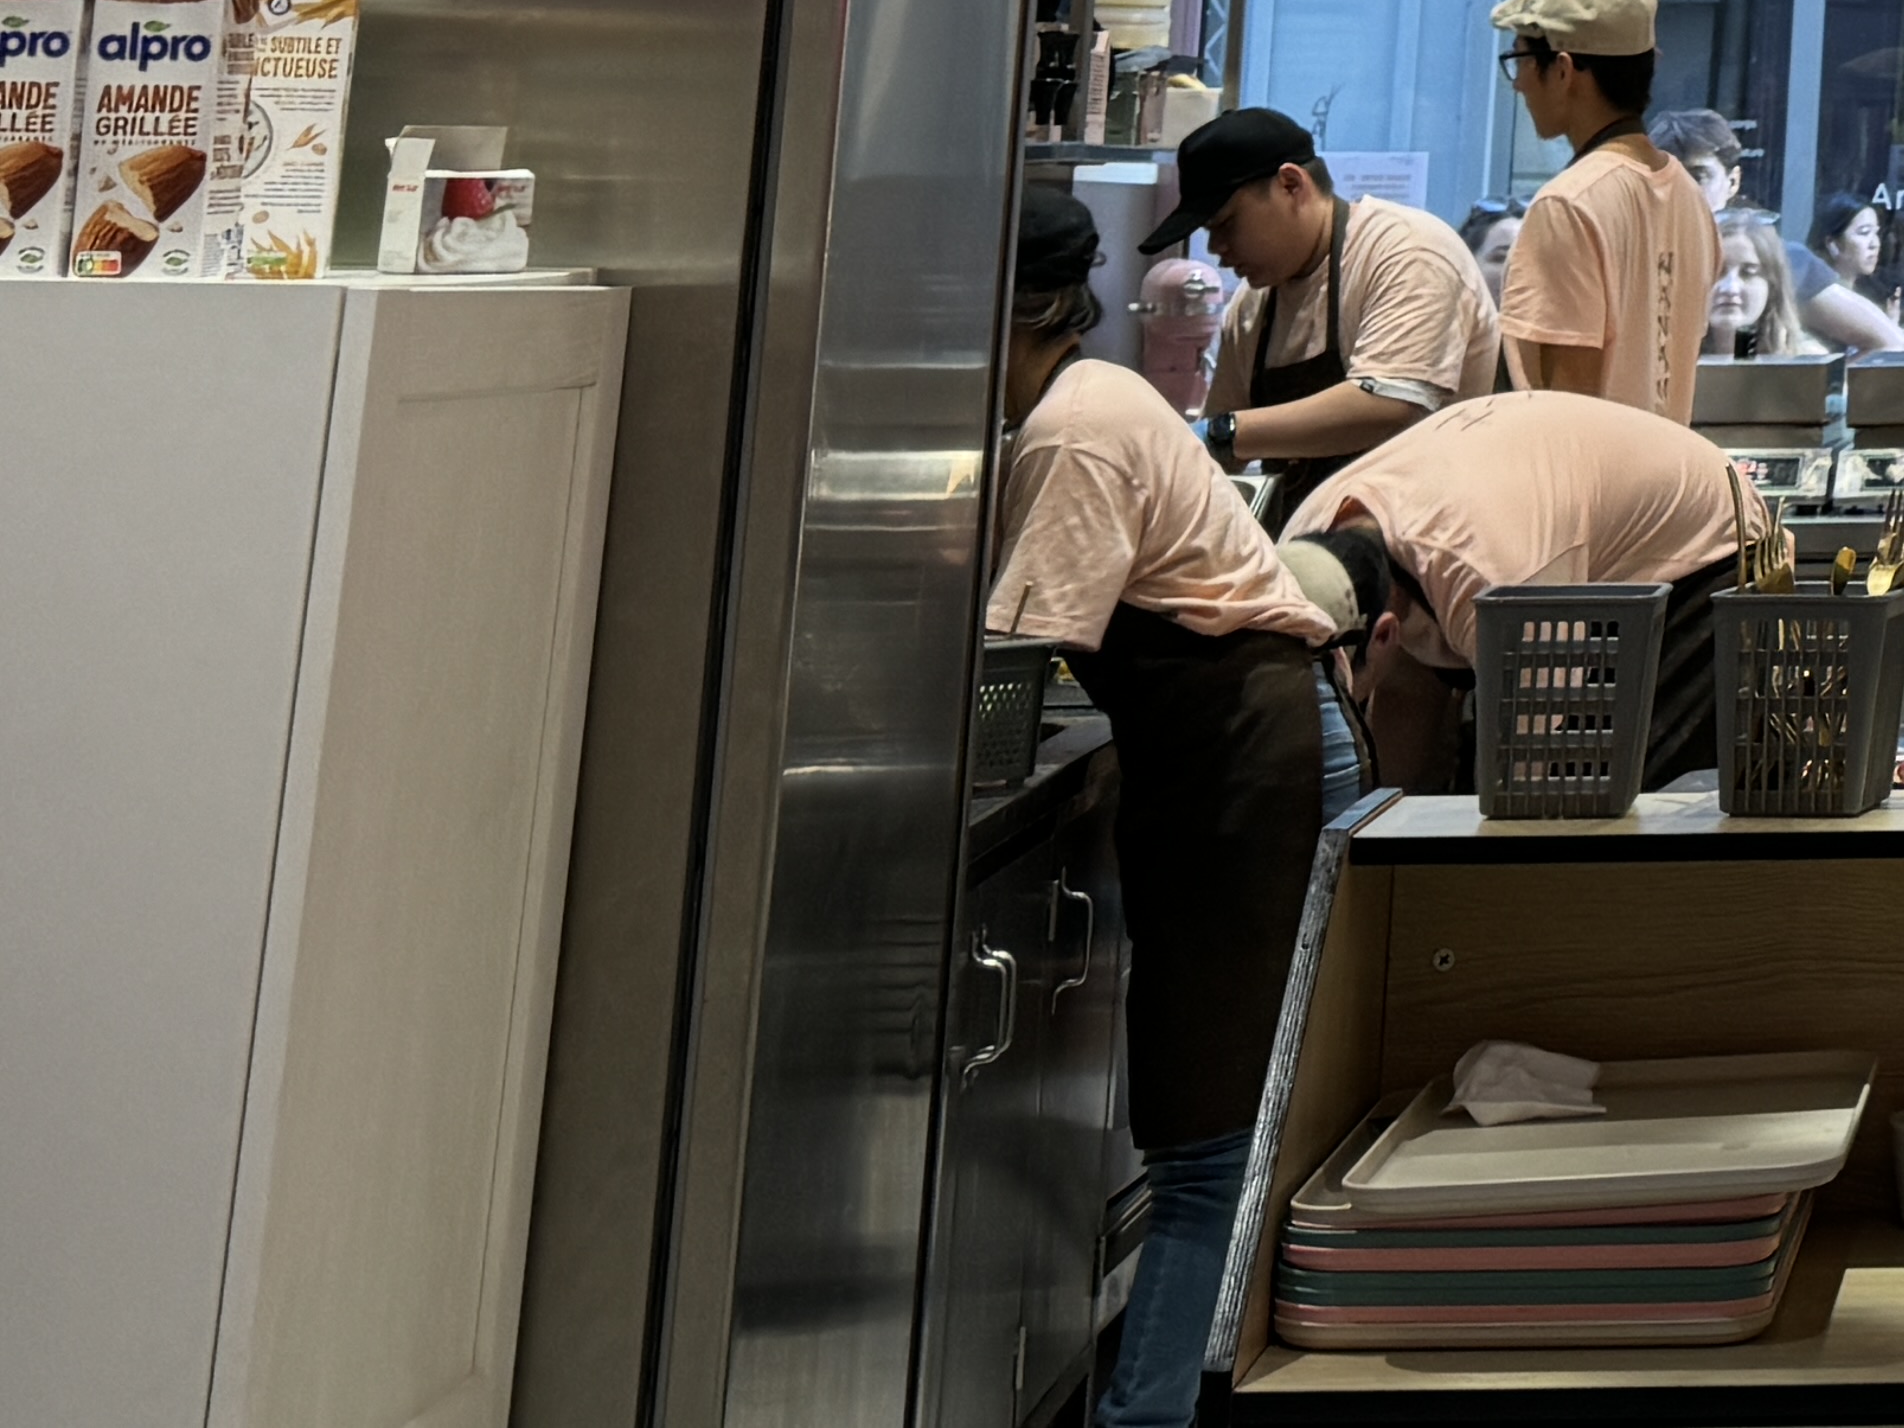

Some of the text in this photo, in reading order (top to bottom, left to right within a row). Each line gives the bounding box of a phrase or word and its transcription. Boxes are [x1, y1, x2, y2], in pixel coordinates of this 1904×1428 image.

[97, 21, 211, 71] alpro
[271, 36, 322, 54] SUBTILE
[326, 37, 342, 54] ET
[96, 84, 202, 113] AMANDE
[95, 113, 198, 136] GRILLÉE
